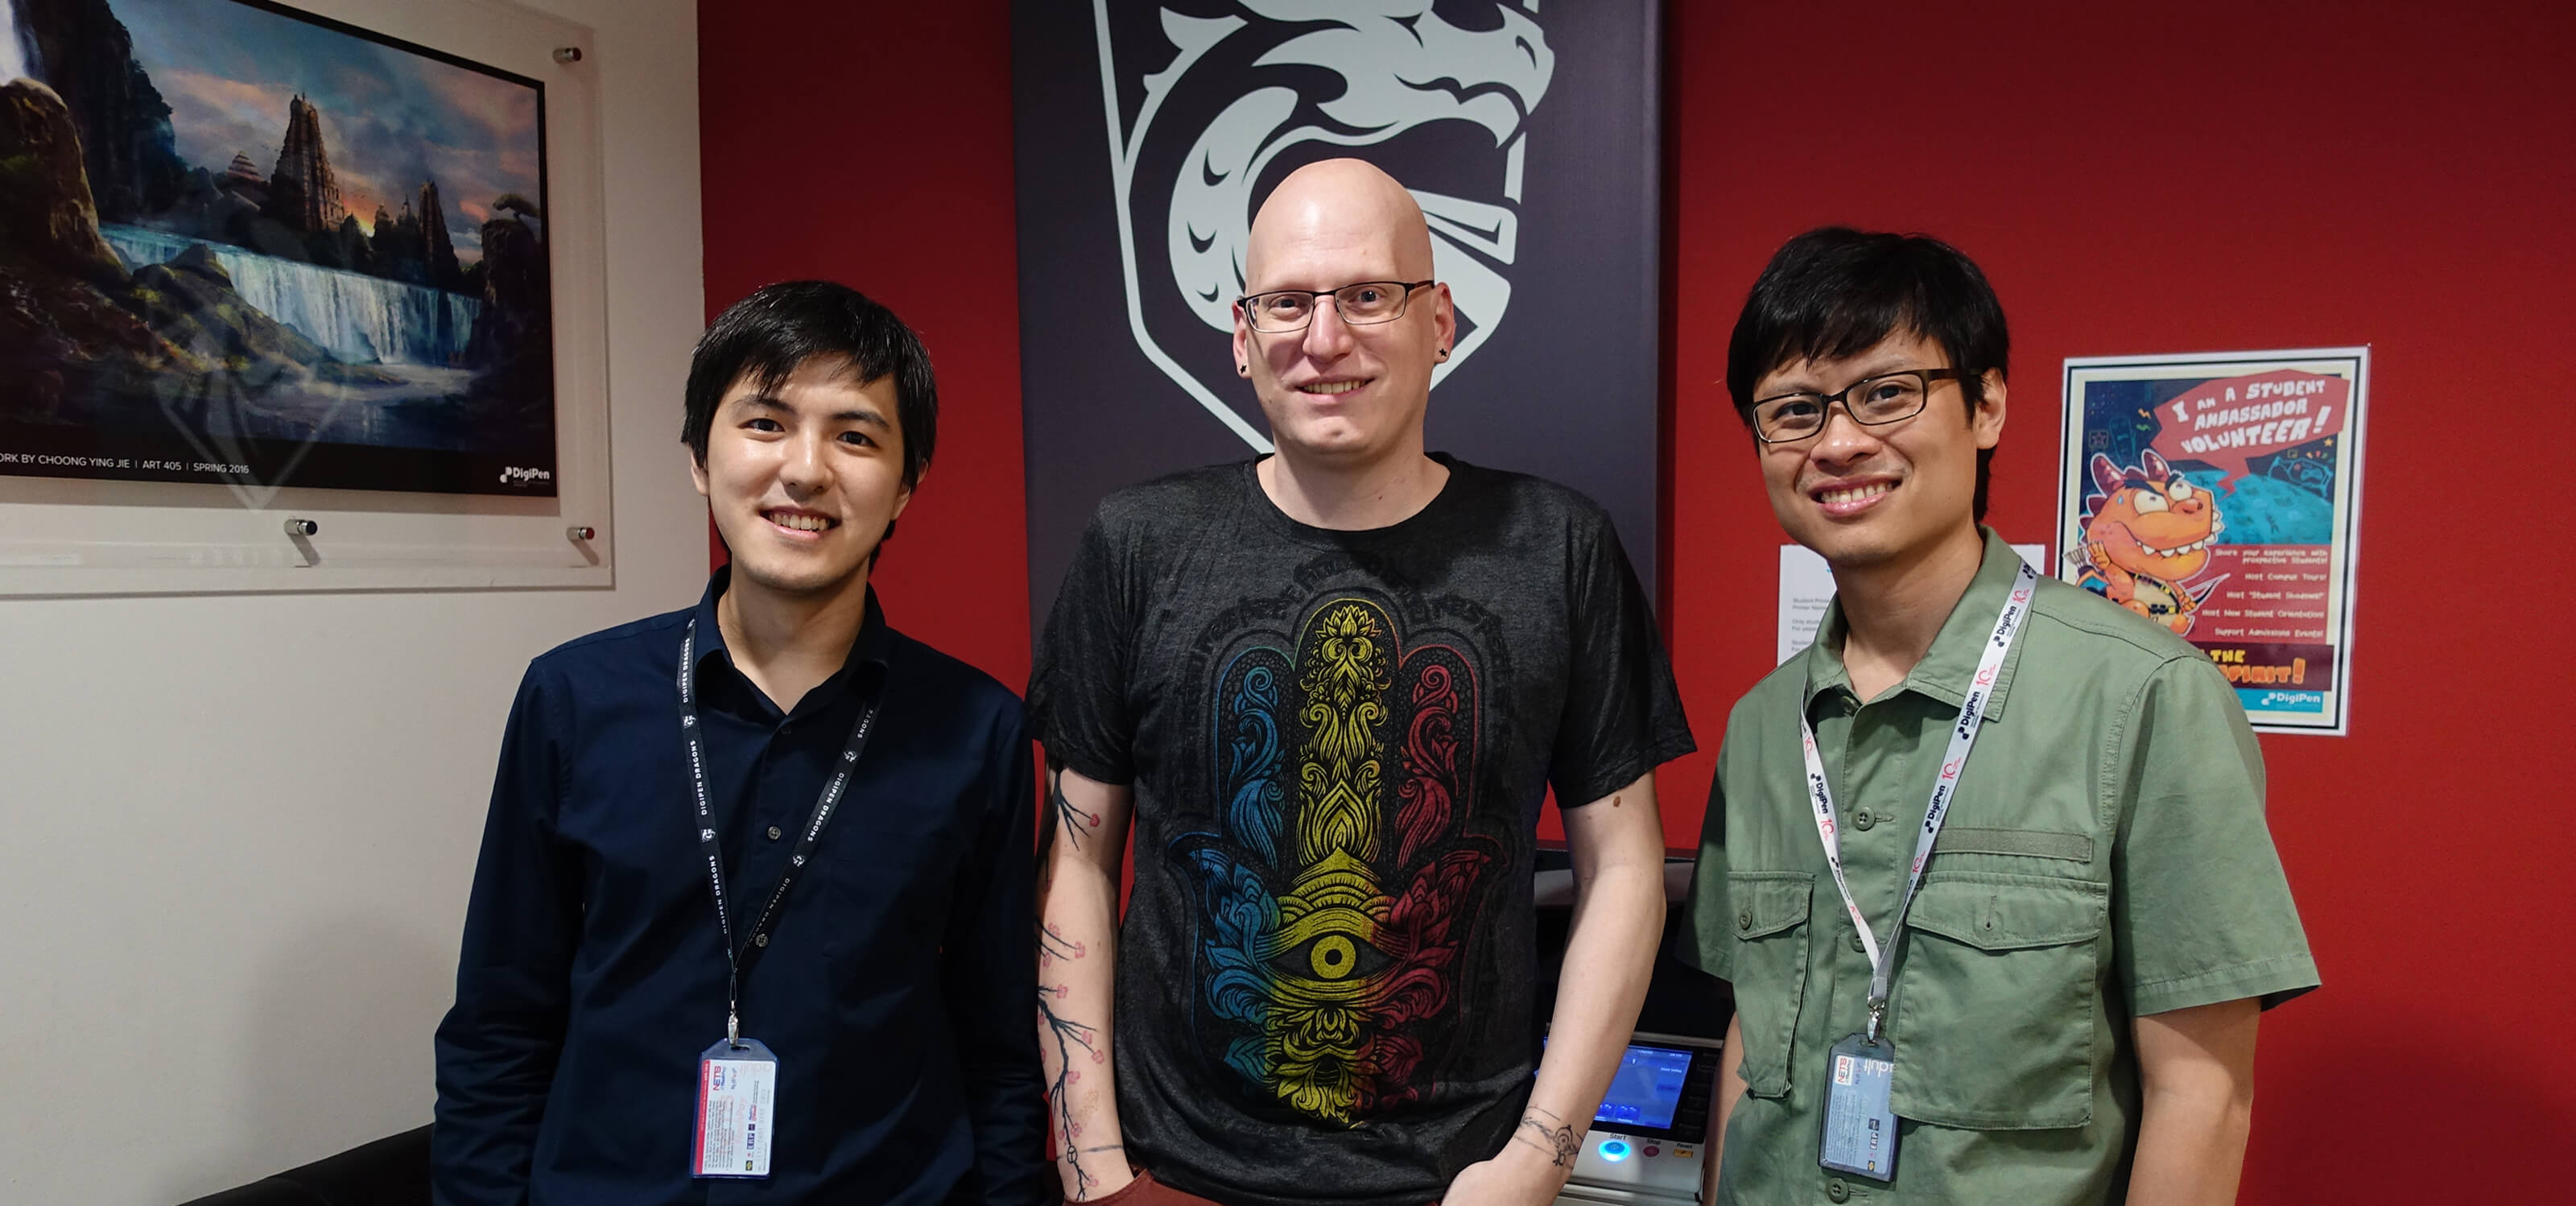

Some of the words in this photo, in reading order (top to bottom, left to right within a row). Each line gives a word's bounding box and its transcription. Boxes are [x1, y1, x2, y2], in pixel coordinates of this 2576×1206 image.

[2172, 400, 2190, 423] I
[2225, 387, 2236, 402] A
[2245, 379, 2326, 399] STUDENT
[2194, 398, 2308, 431] AMBASSADOR
[2181, 406, 2332, 454] VOLUNTEER!
[21, 453, 35, 464] BY
[38, 455, 87, 466] CHOONG
[89, 457, 114, 468] YING
[116, 459, 130, 469] JIE
[142, 460, 161, 469] ART
[163, 461, 182, 471] 405
[193, 462, 227, 473] SPRING
[229, 464, 250, 474] 2016
[513, 466, 550, 481] DigiPen
[1996, 605, 2017, 635] DigiPen
[683, 638, 691, 671] DRAGONS
[2210, 649, 2246, 663] THE
[1960, 691, 1980, 726] DigiPen
[2277, 692, 2321, 704] DigiPen
[690, 740, 702, 779] DRAGONS
[696, 781, 708, 816] DIGIPEN
[826, 772, 845, 803] DIGIPEN
[1816, 783, 1829, 814] DigiPen
[1927, 785, 1946, 820] DigiPen
[807, 805, 829, 842] DRAGONS
[708, 855, 721, 896] DRAGONS
[712, 1065, 721, 1091] NETS
[1838, 1057, 1847, 1083] NETS
[1609, 1133, 1627, 1141] Start
[1870, 1133, 1879, 1150] ERP
